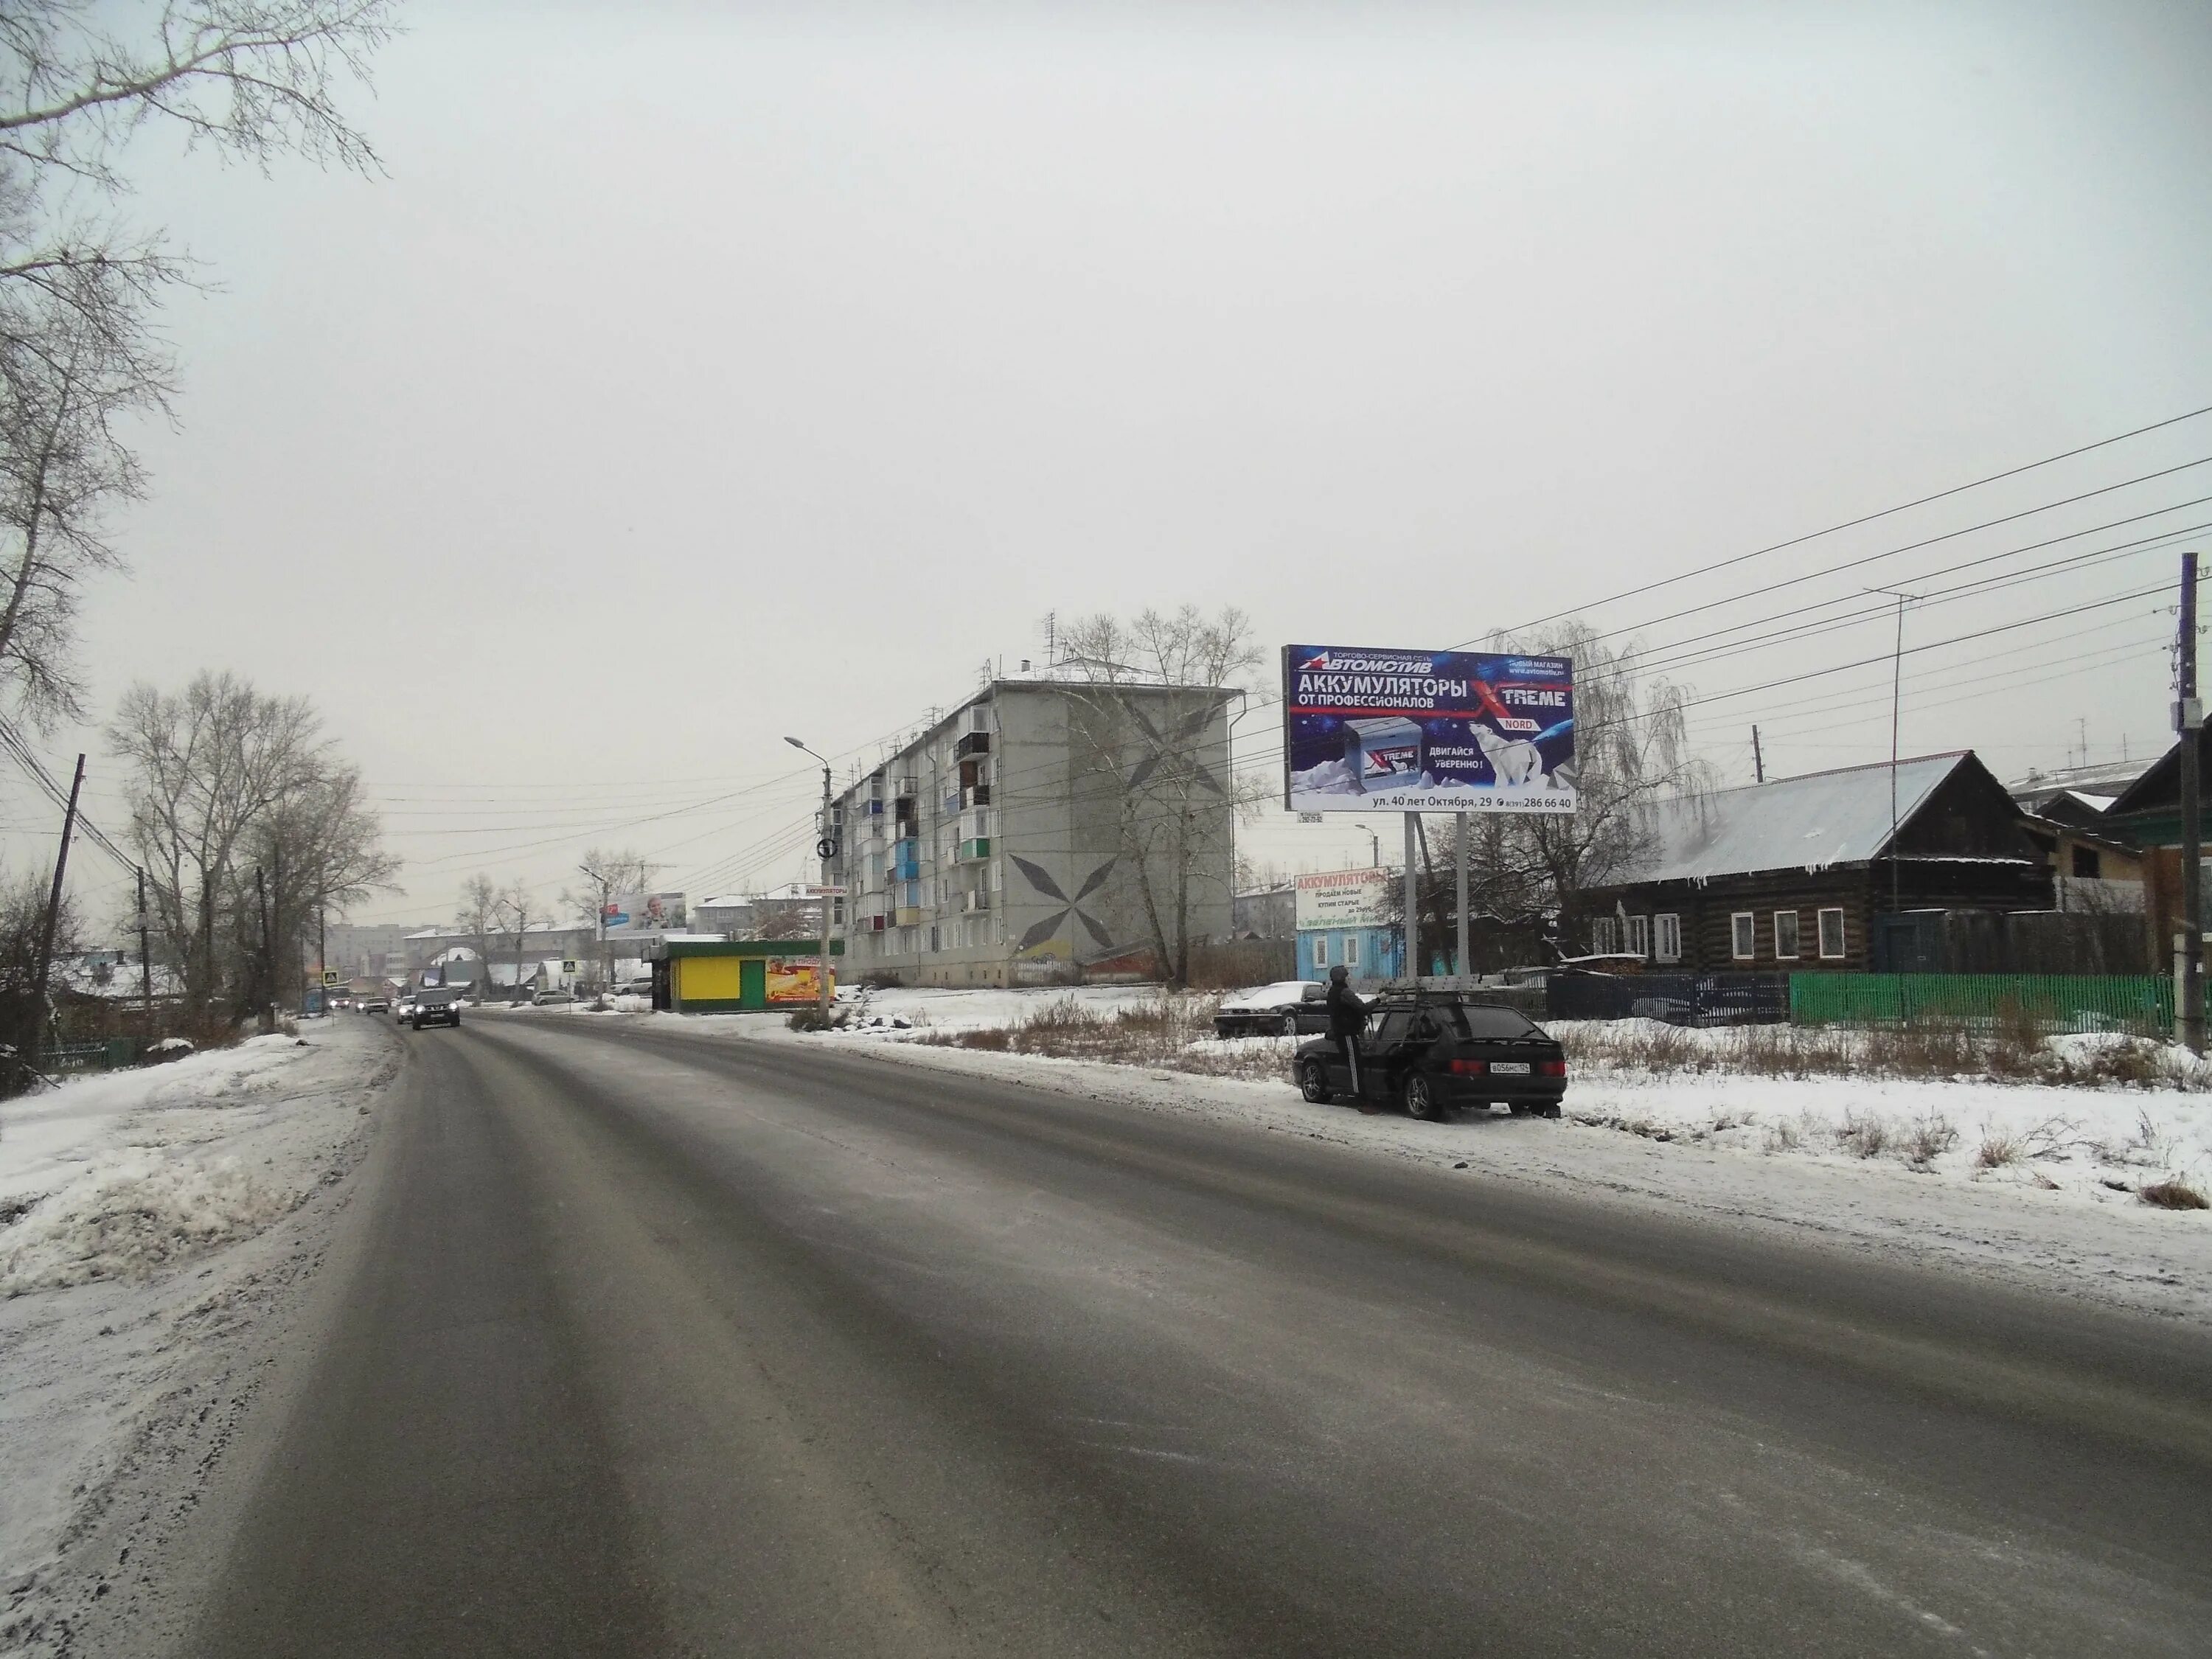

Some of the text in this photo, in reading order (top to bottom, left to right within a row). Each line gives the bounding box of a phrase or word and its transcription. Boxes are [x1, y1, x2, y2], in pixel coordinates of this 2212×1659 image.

[1333, 652, 1411, 661] ТОРГОВО-СЕРВИСНАЯ
[1298, 651, 1433, 674] АВТОМОТИВ
[1509, 660, 1563, 669] НОВЫЙ МАГАЗИН
[1509, 668, 1564, 676] www.avtomotiv.ru
[1298, 674, 1467, 698] АККУМУЛЯТОРЫ
[1298, 694, 1434, 709] ОТ ПРОФЕССИОНАЛОВ
[1506, 720, 1533, 729] NORD
[1429, 746, 1474, 757] ДВИГАЙСЯ
[1373, 798, 1389, 808] ул.
[1391, 796, 1405, 806] 40
[1407, 798, 1425, 807] лет
[1428, 796, 1477, 808] Октября,
[1480, 797, 1492, 807] 29
[1545, 799, 1557, 807] 66
[1559, 799, 1571, 808] 40
